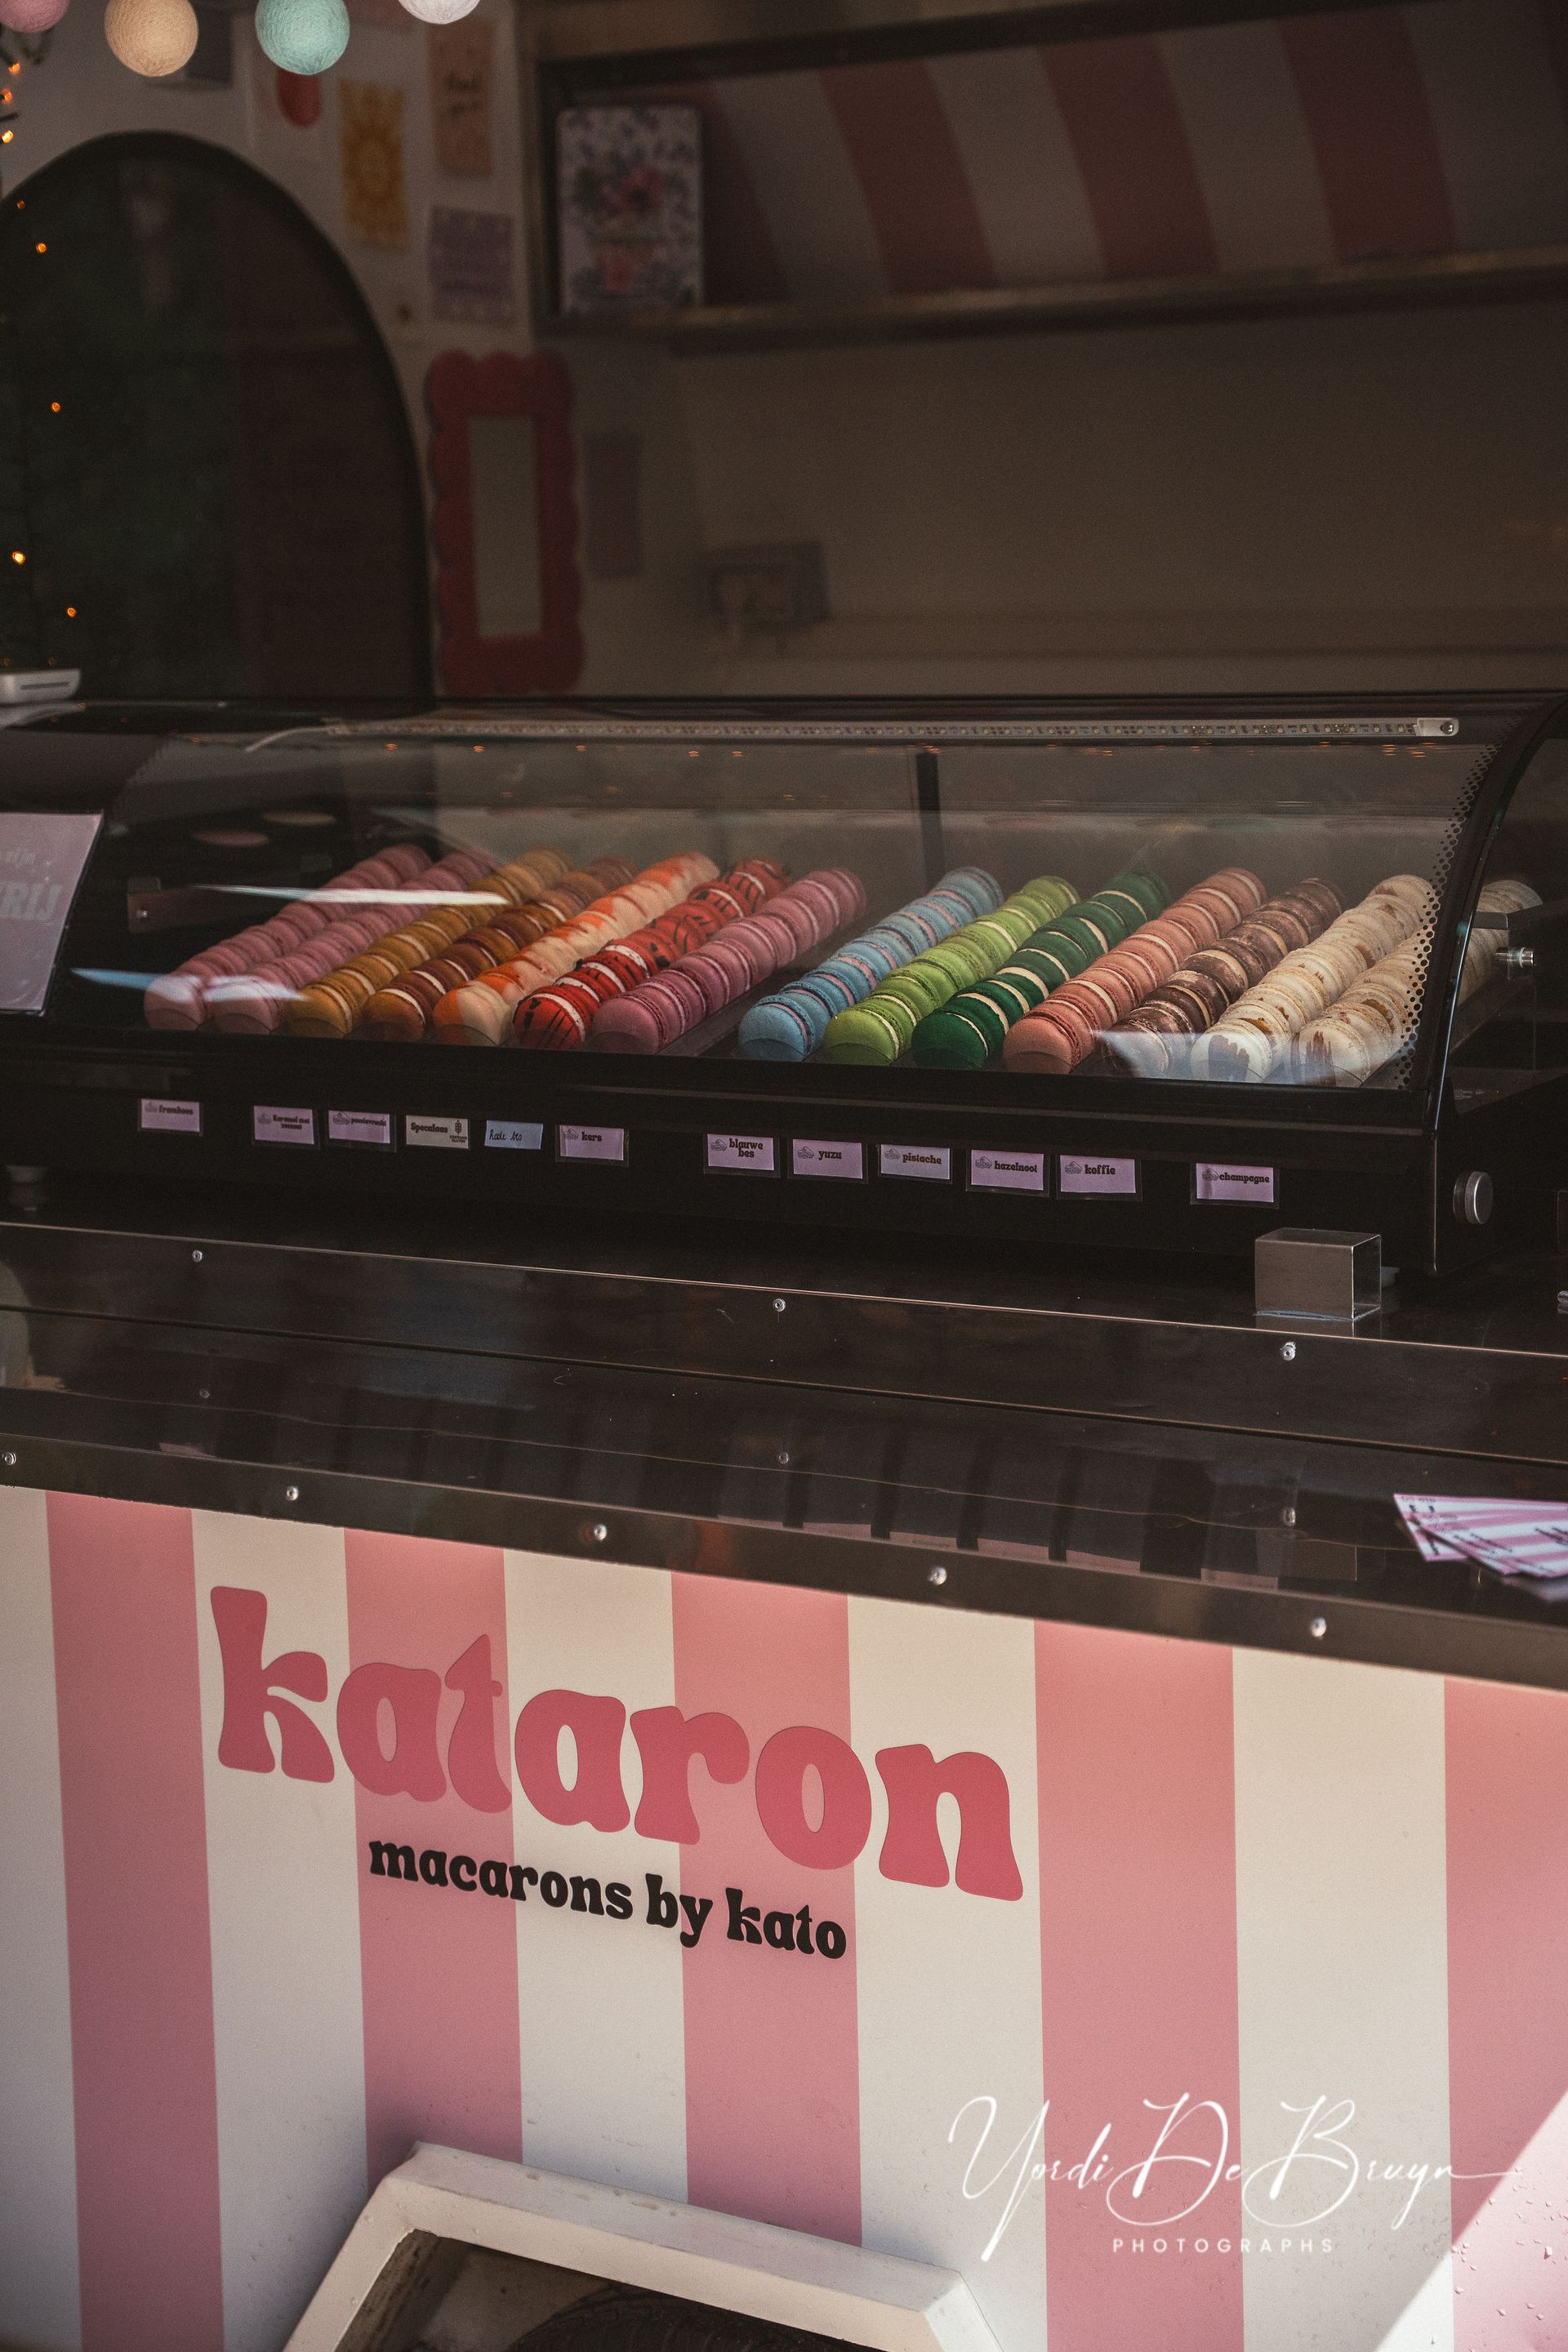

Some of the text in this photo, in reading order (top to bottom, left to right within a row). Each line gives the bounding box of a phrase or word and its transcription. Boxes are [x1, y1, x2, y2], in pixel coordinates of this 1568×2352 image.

[410, 1122, 448, 1134] Speculoos
[728, 1138, 764, 1150] blauwe
[738, 1148, 755, 1158] bes
[817, 1150, 842, 1160] yuzu
[902, 1152, 942, 1165] pistache
[994, 1160, 1038, 1174] hazelnoot
[1084, 1164, 1116, 1175] koffie
[1219, 1172, 1270, 1185] champagne
[210, 1585, 1024, 1902] kataron
[368, 1839, 847, 1959] macarons by kato
